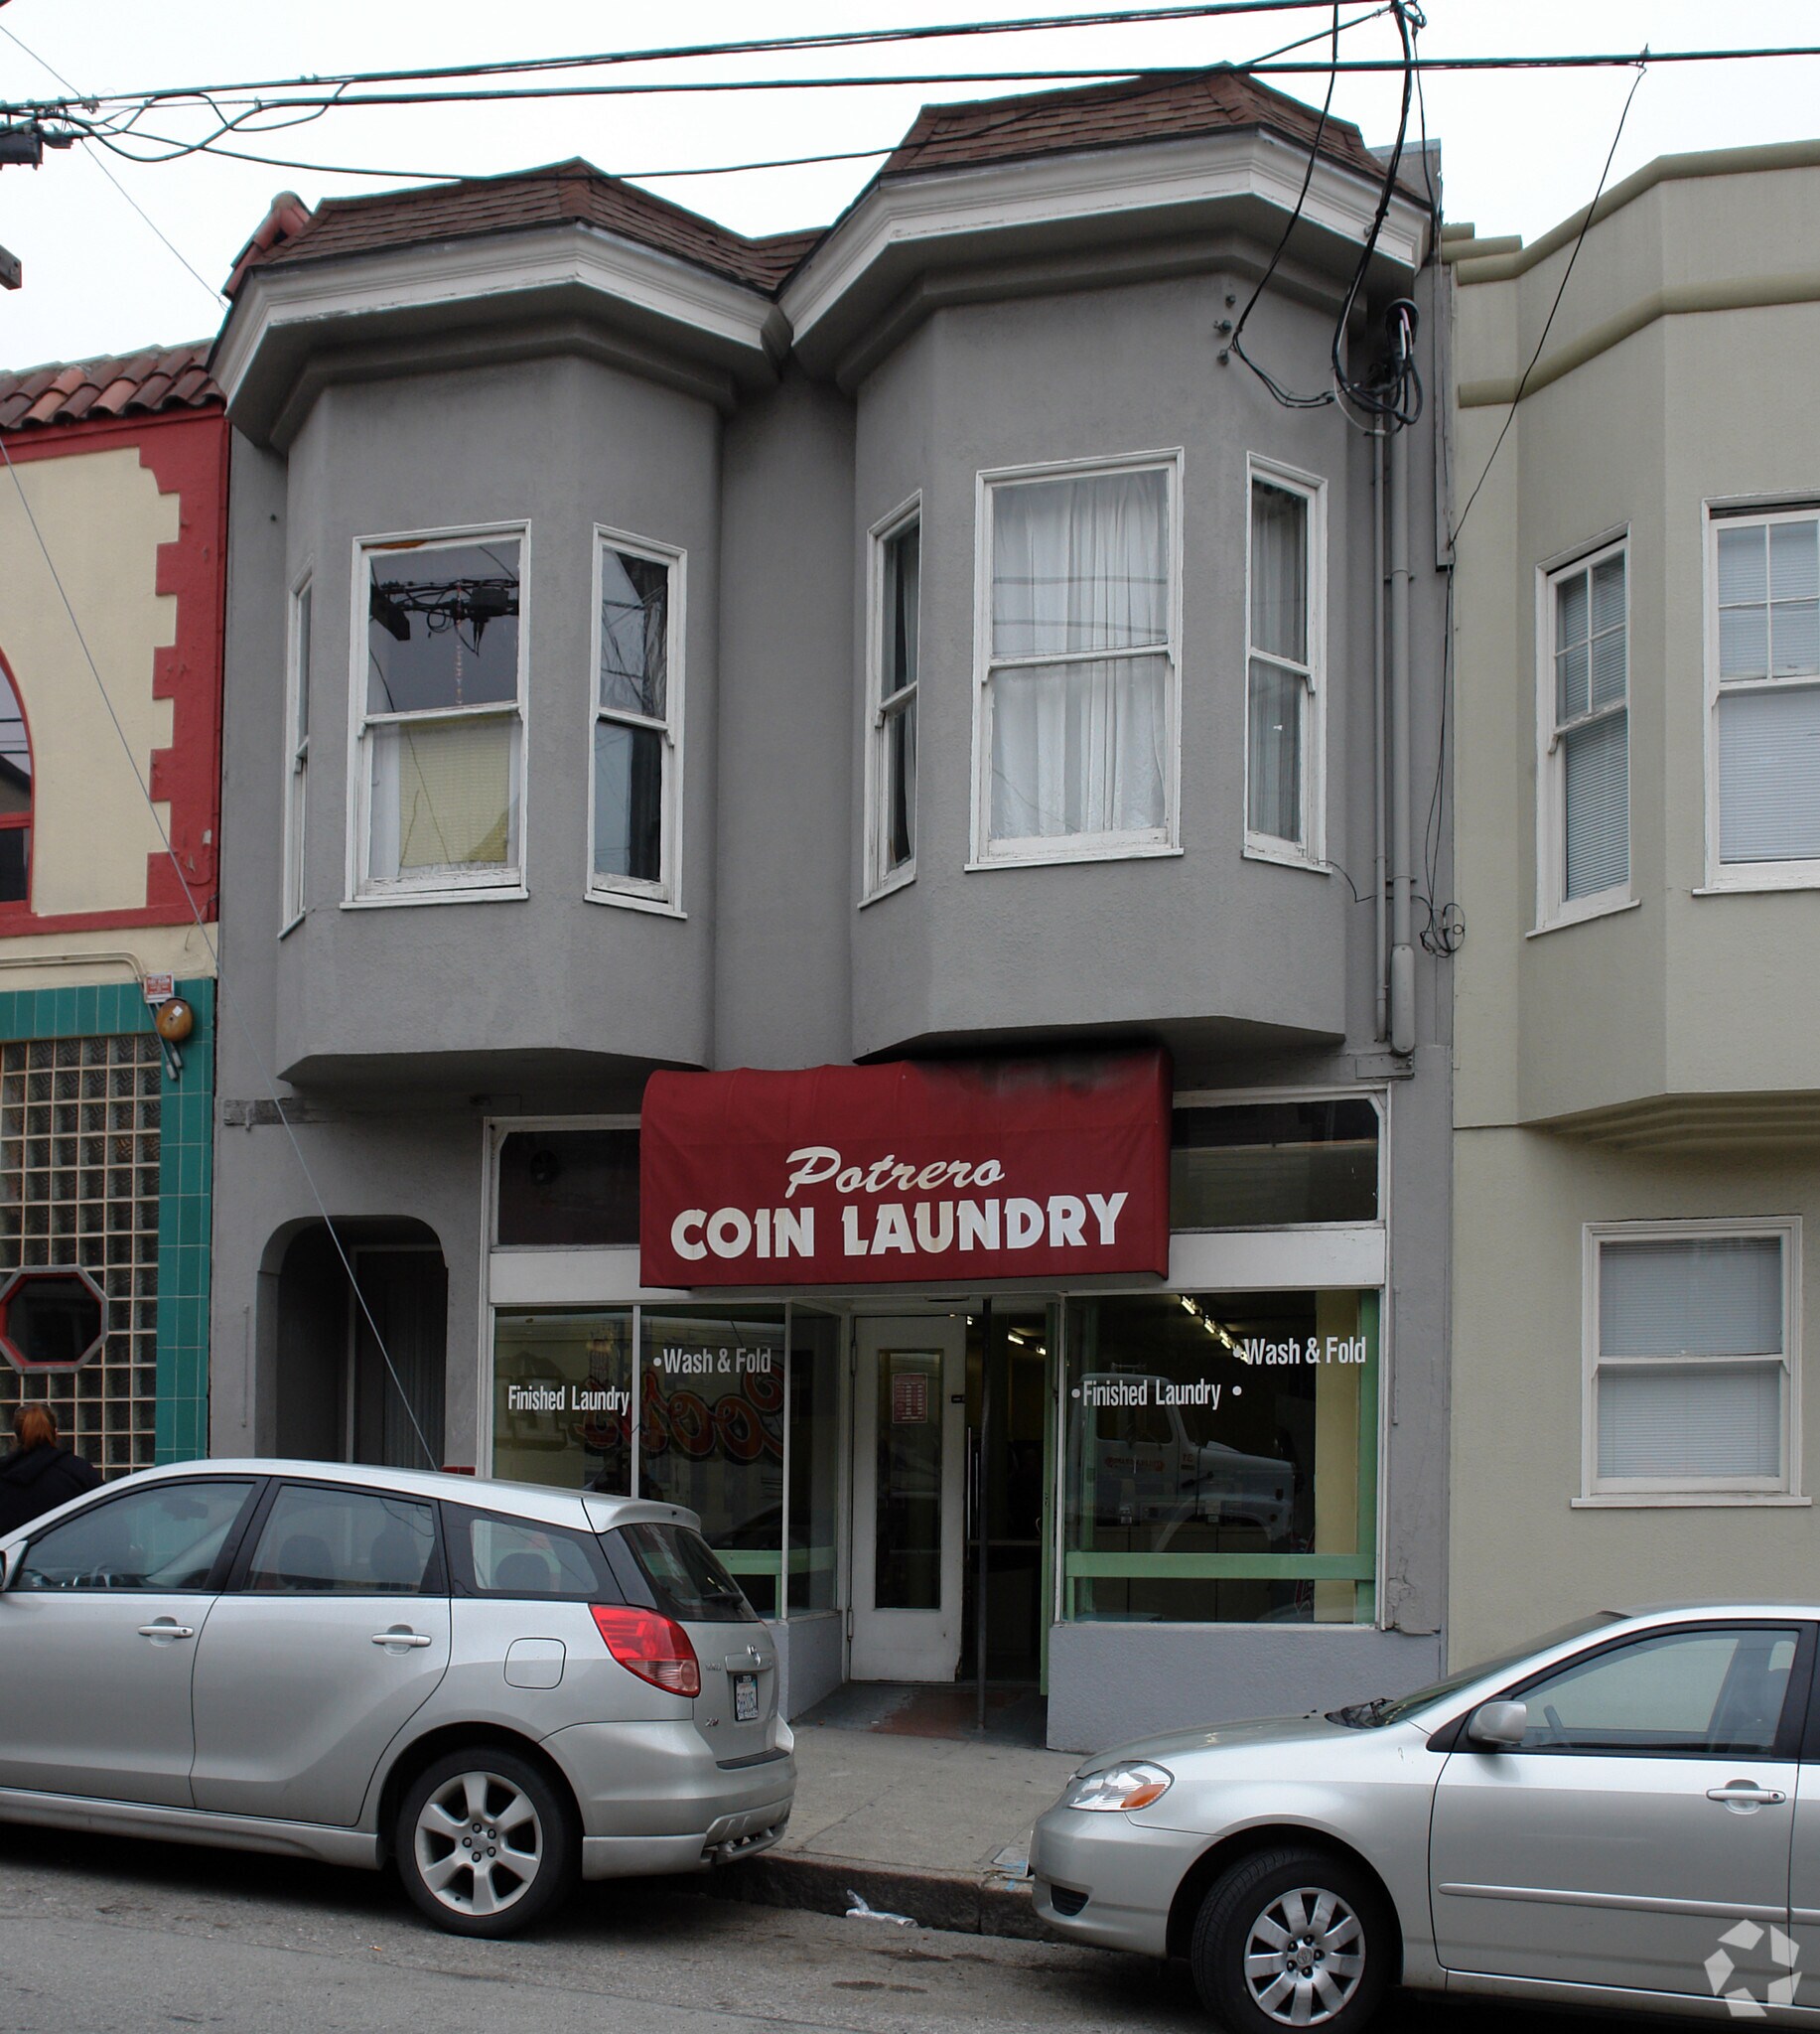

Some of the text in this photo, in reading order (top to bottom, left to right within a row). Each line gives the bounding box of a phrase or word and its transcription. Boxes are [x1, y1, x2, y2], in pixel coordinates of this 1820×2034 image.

[784, 1145, 1005, 1199] Potrero
[670, 1192, 1129, 1260] COIN LAUNDRY
[663, 1347, 771, 1374] Wash & Fold
[1244, 1336, 1366, 1366] Wash & Fold
[507, 1384, 630, 1416] Finished Laundry
[1083, 1378, 1221, 1410] Finished Laundry
